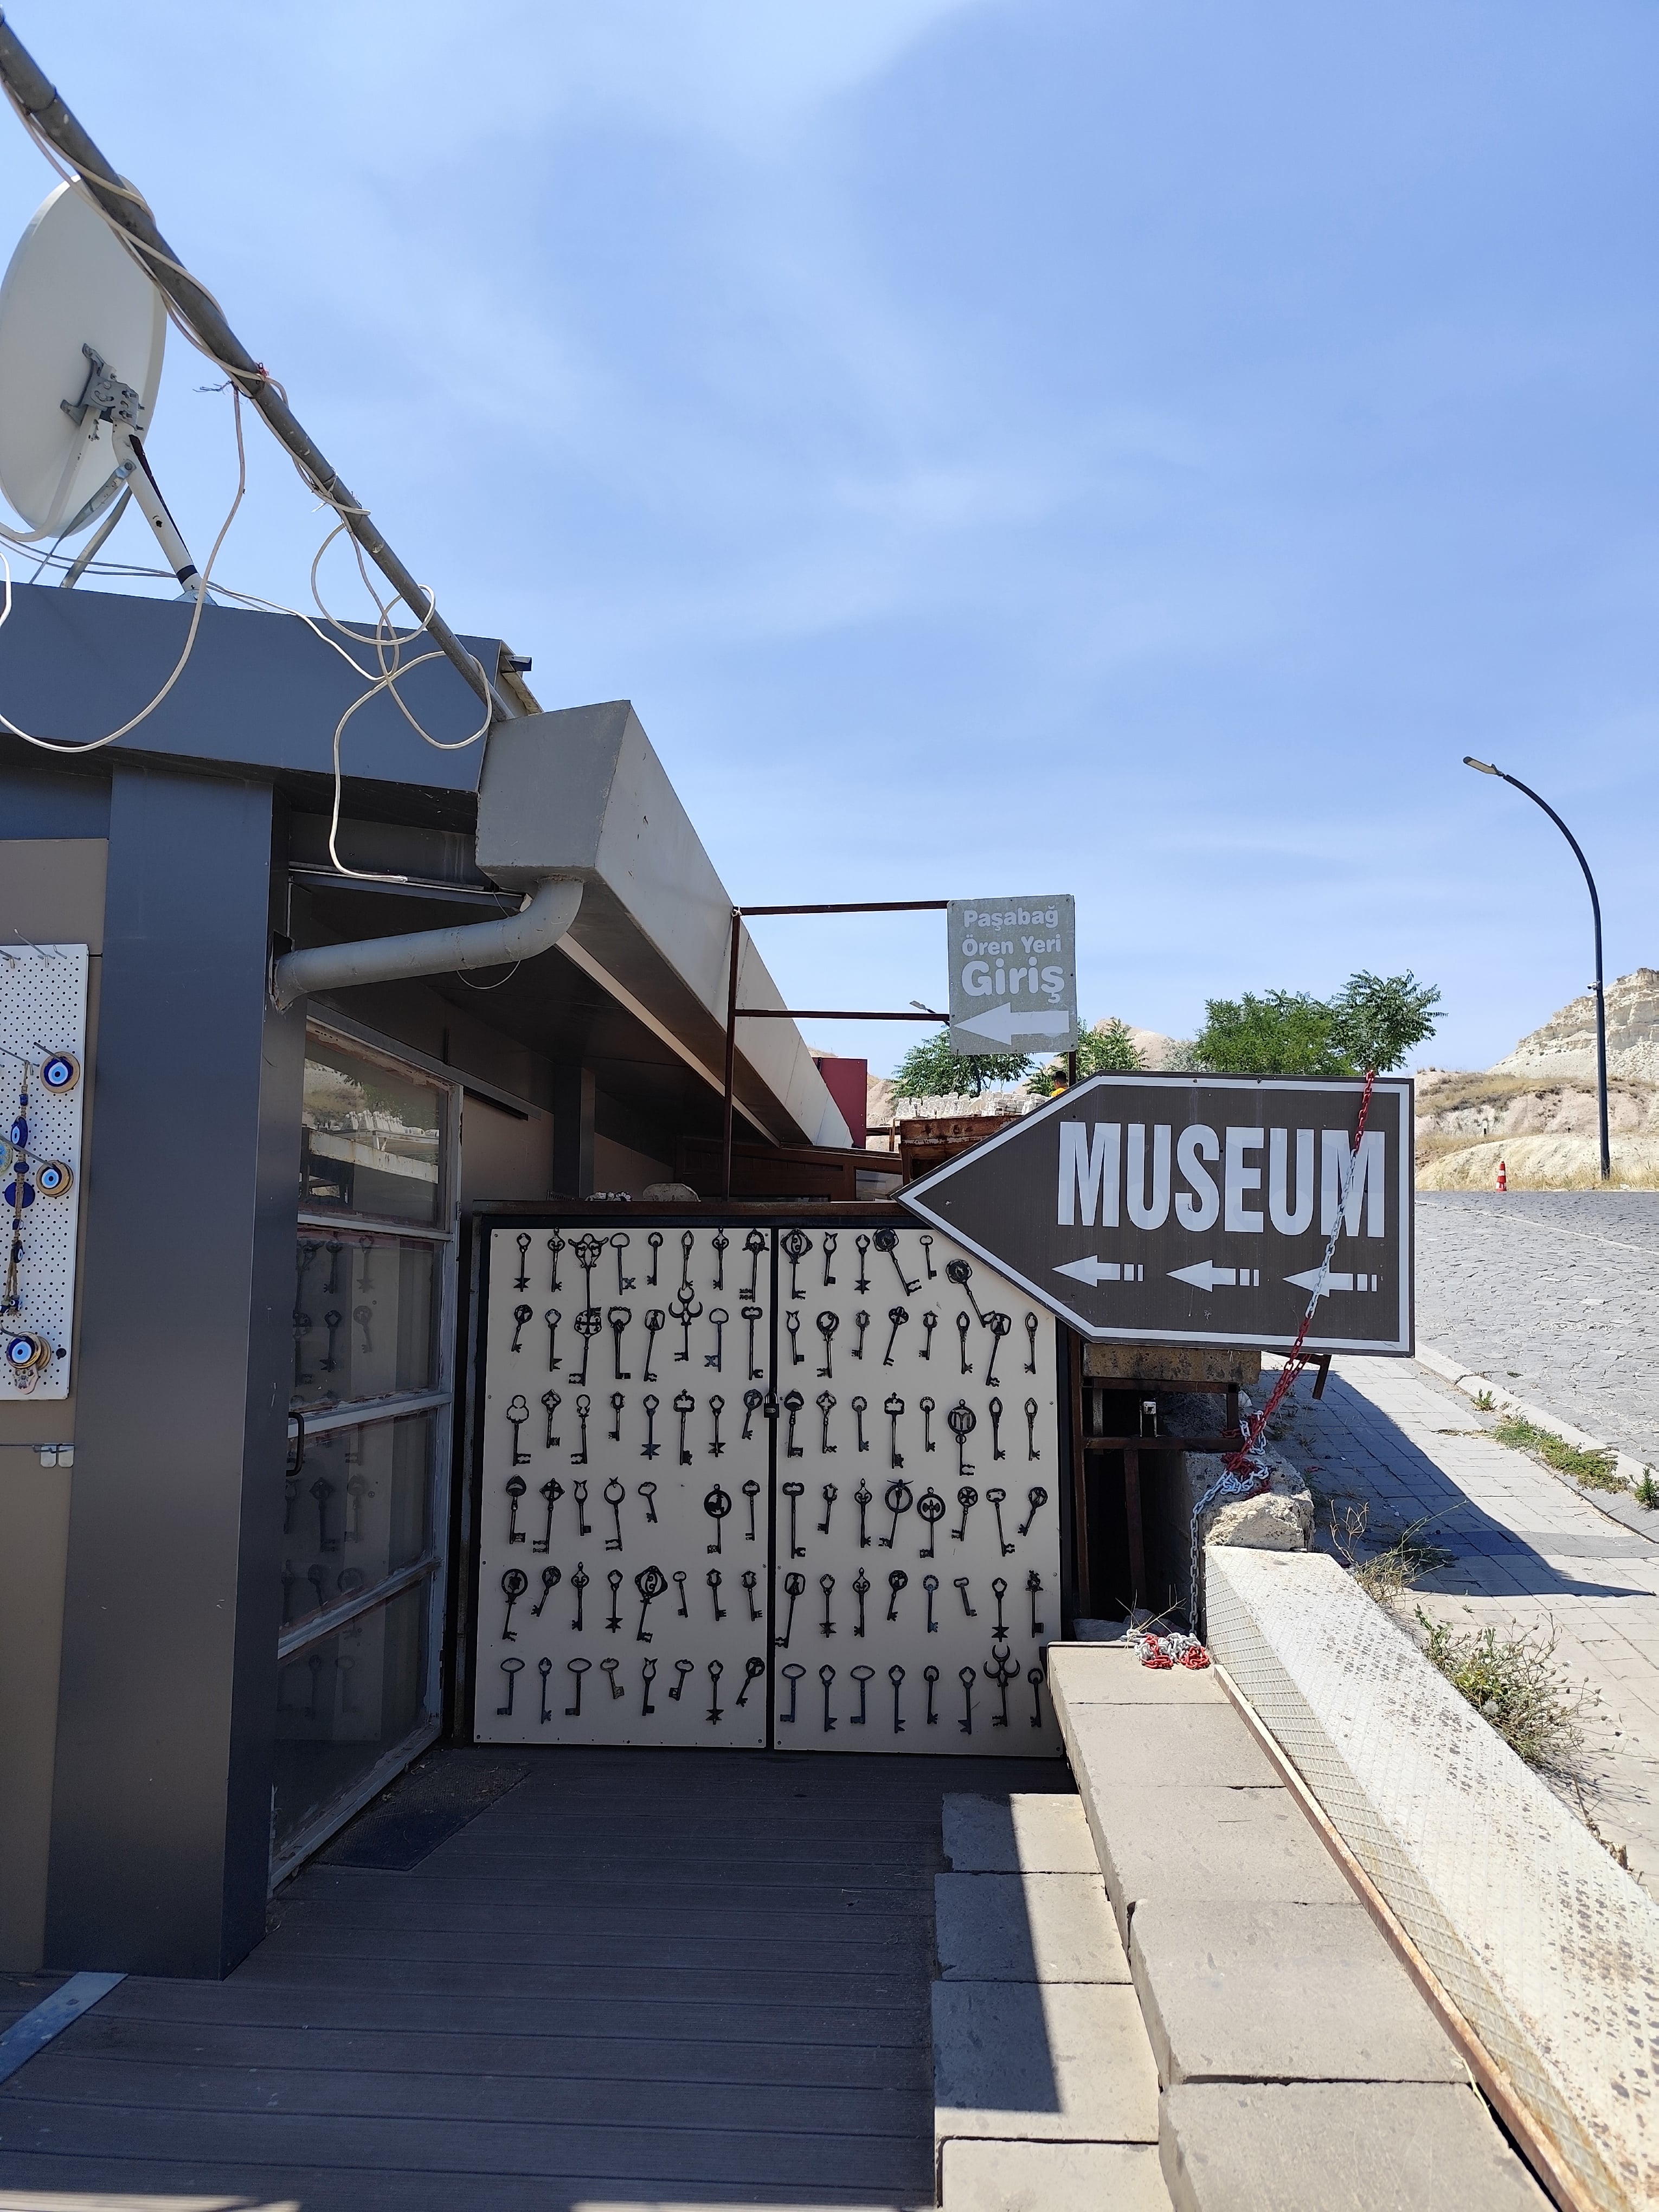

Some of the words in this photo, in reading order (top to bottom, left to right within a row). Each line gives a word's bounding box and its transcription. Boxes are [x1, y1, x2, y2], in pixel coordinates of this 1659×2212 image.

[963, 904, 1058, 931] Paşabağ
[962, 934, 1014, 956] Ören
[1021, 934, 1062, 954] Yeri
[961, 956, 1065, 1004] Giriş
[1057, 1121, 1385, 1238] MUSEUM
